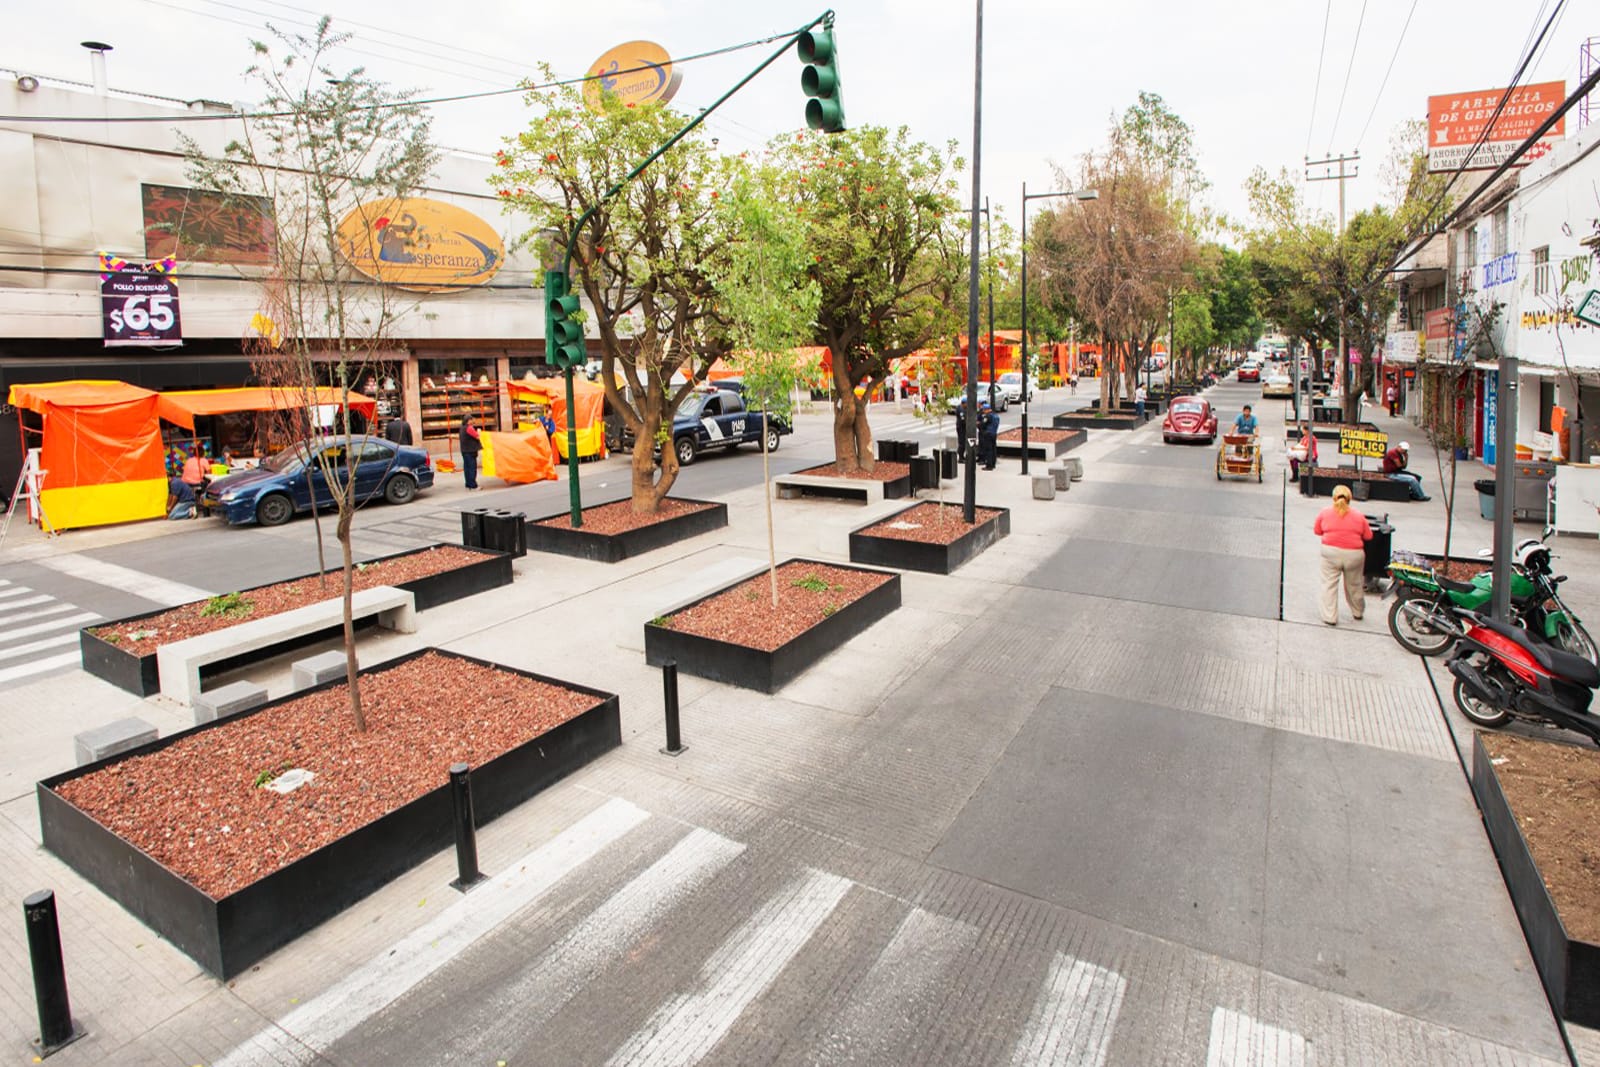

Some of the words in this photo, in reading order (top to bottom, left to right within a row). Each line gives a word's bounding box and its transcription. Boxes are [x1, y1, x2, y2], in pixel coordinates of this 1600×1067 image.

[1451, 92, 1541, 110] FARMCIA
[1440, 112, 1460, 124] DE
[1505, 143, 1516, 152] DE
[113, 283, 134, 292] POLLO
[110, 294, 174, 333] $65
